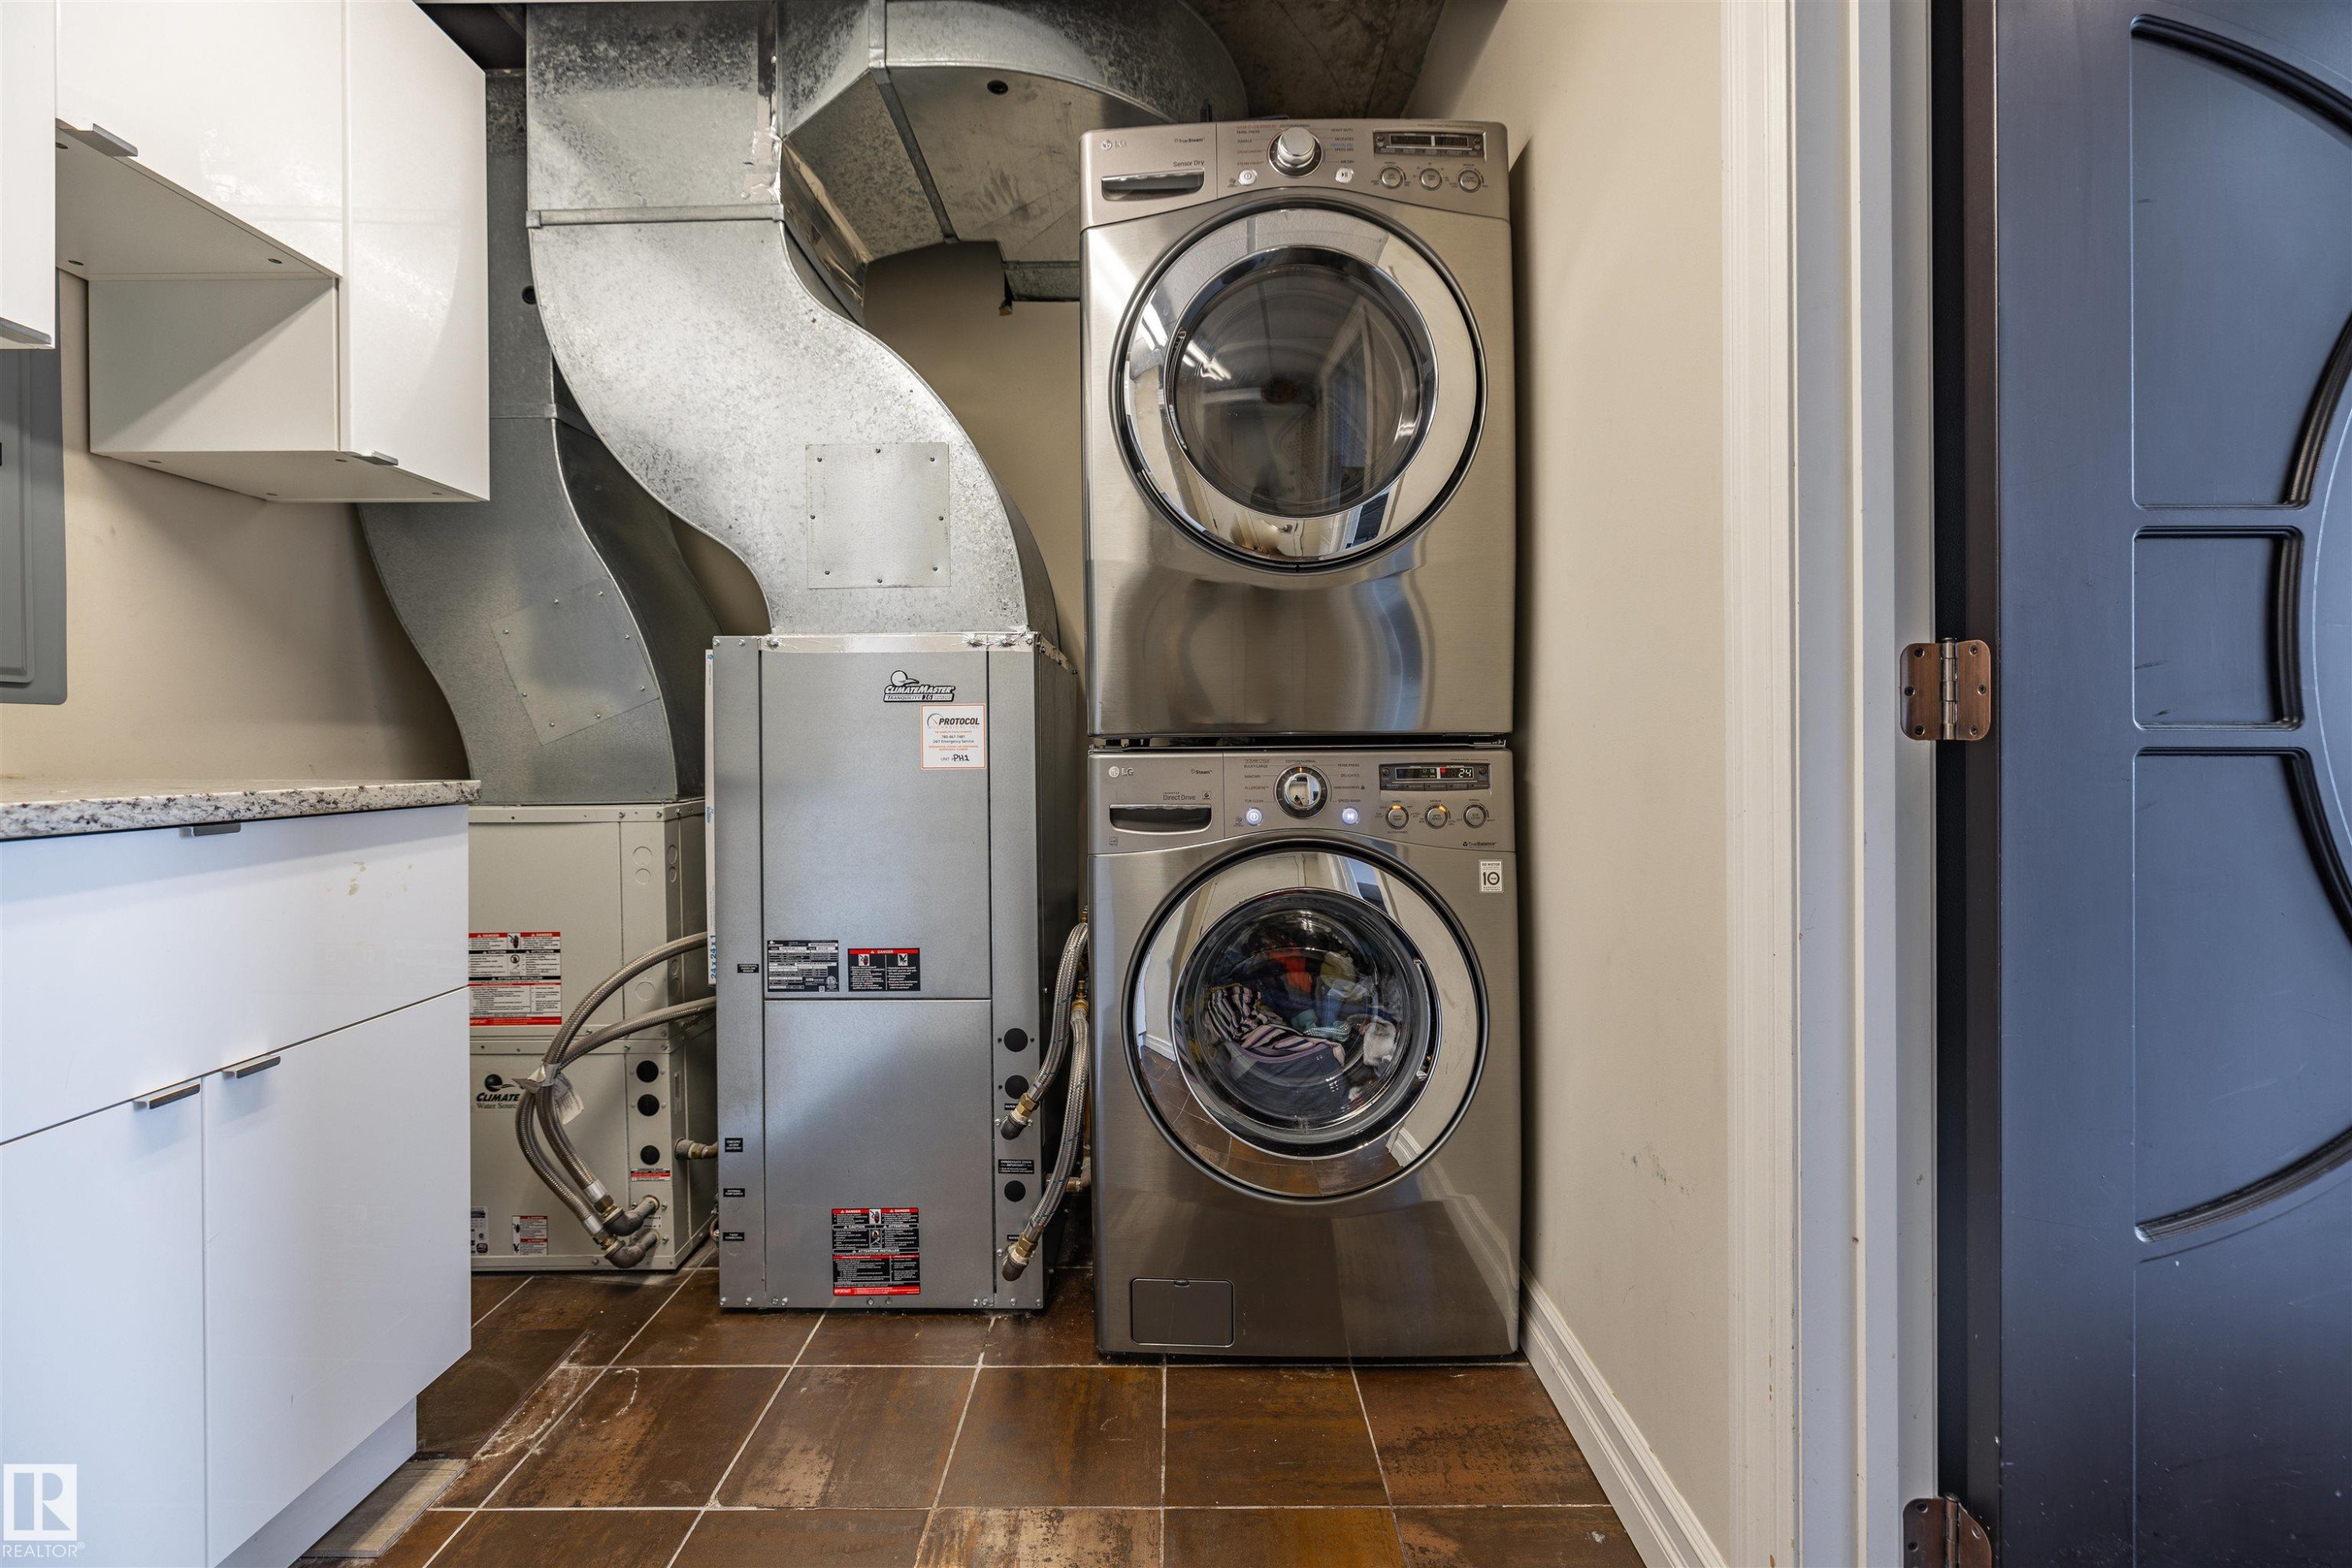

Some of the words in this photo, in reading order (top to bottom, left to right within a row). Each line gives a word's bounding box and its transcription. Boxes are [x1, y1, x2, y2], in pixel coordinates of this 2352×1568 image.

[1122, 768, 1134, 776] LG
[1458, 768, 1472, 778] 24
[1483, 872, 1500, 885] 10
[710, 948, 717, 959] 24
[711, 968, 717, 979] 24
